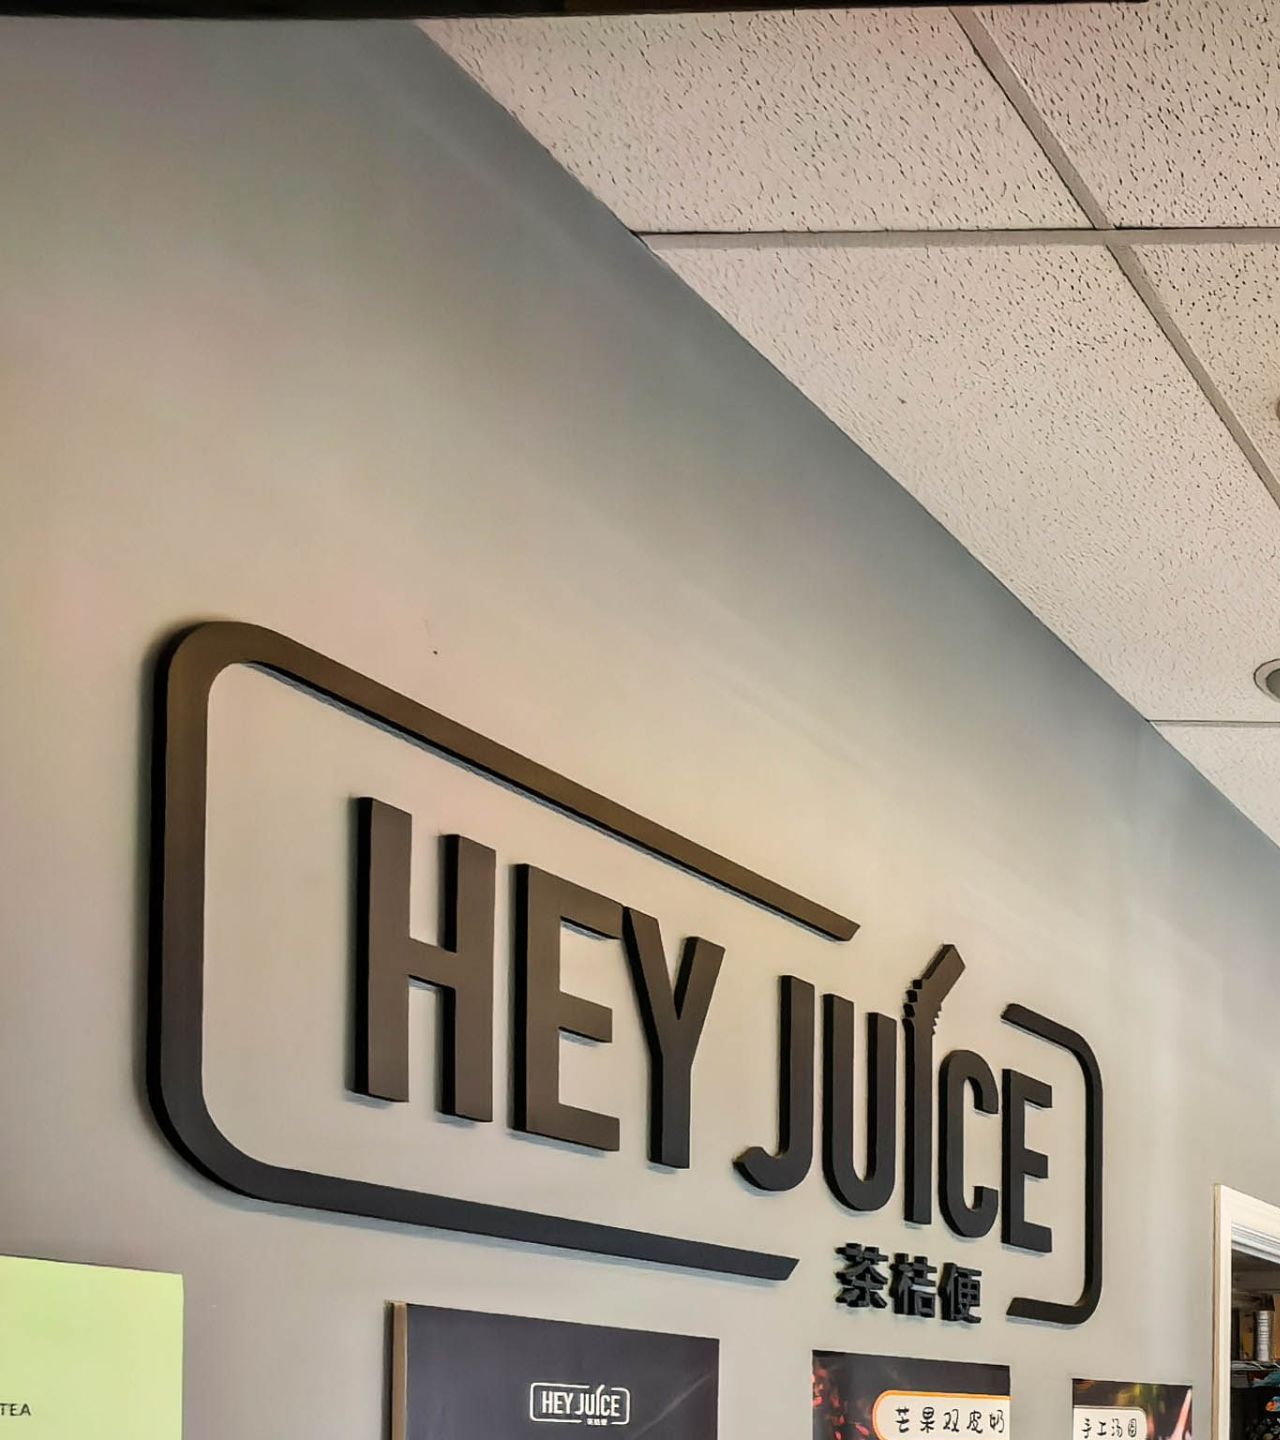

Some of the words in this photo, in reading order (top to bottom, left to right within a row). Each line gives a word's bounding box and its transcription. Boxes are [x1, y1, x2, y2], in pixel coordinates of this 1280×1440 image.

[347, 796, 726, 1170] HEY
[732, 943, 1054, 1253] JUICE
[541, 1390, 574, 1415] HEY
[574, 1384, 621, 1417] JUICE
